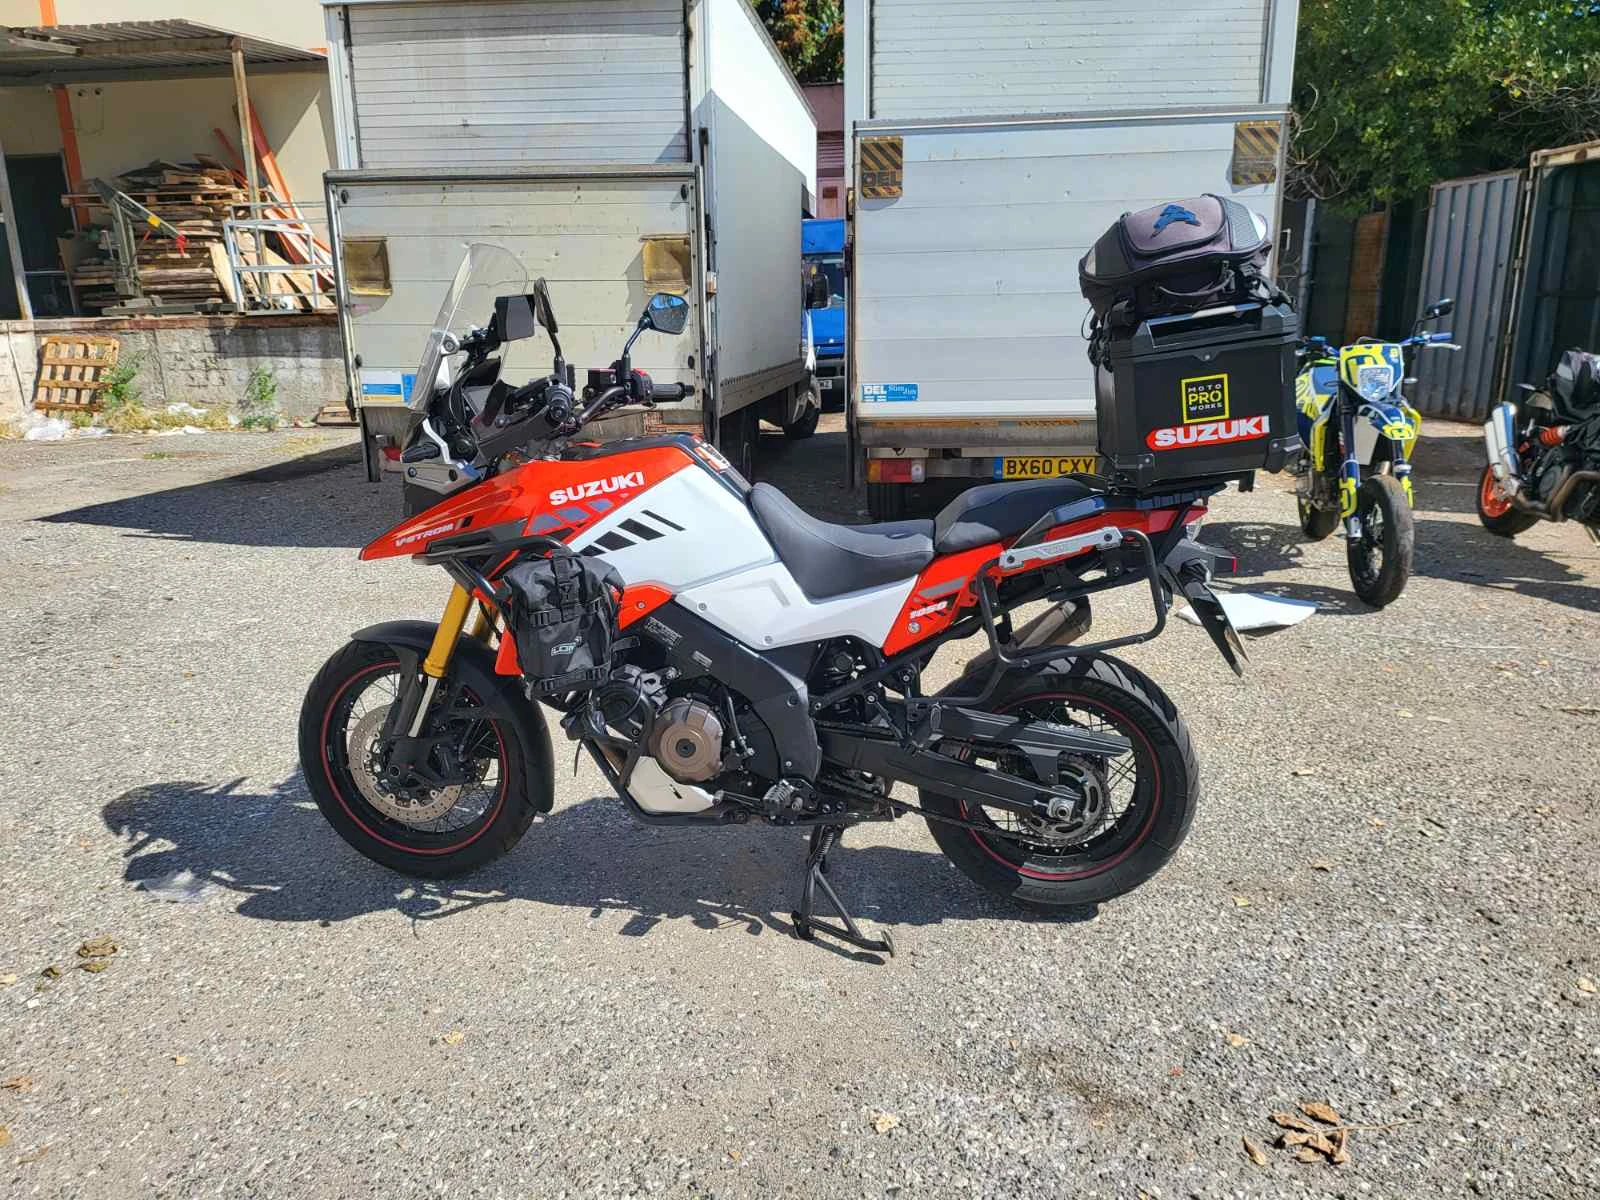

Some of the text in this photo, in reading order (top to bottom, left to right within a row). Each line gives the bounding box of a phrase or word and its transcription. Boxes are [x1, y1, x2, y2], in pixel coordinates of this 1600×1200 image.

[864, 171, 902, 186] DEL
[863, 385, 887, 395] DEL
[1187, 383, 1222, 393] MOTO
[1188, 390, 1222, 406] PRO
[1189, 402, 1223, 412] WORKS
[1154, 415, 1270, 447] SUZUKI
[1006, 458, 1093, 475] BX60 CXY
[549, 471, 645, 506] SUZUKI
[910, 600, 948, 619] 1050
